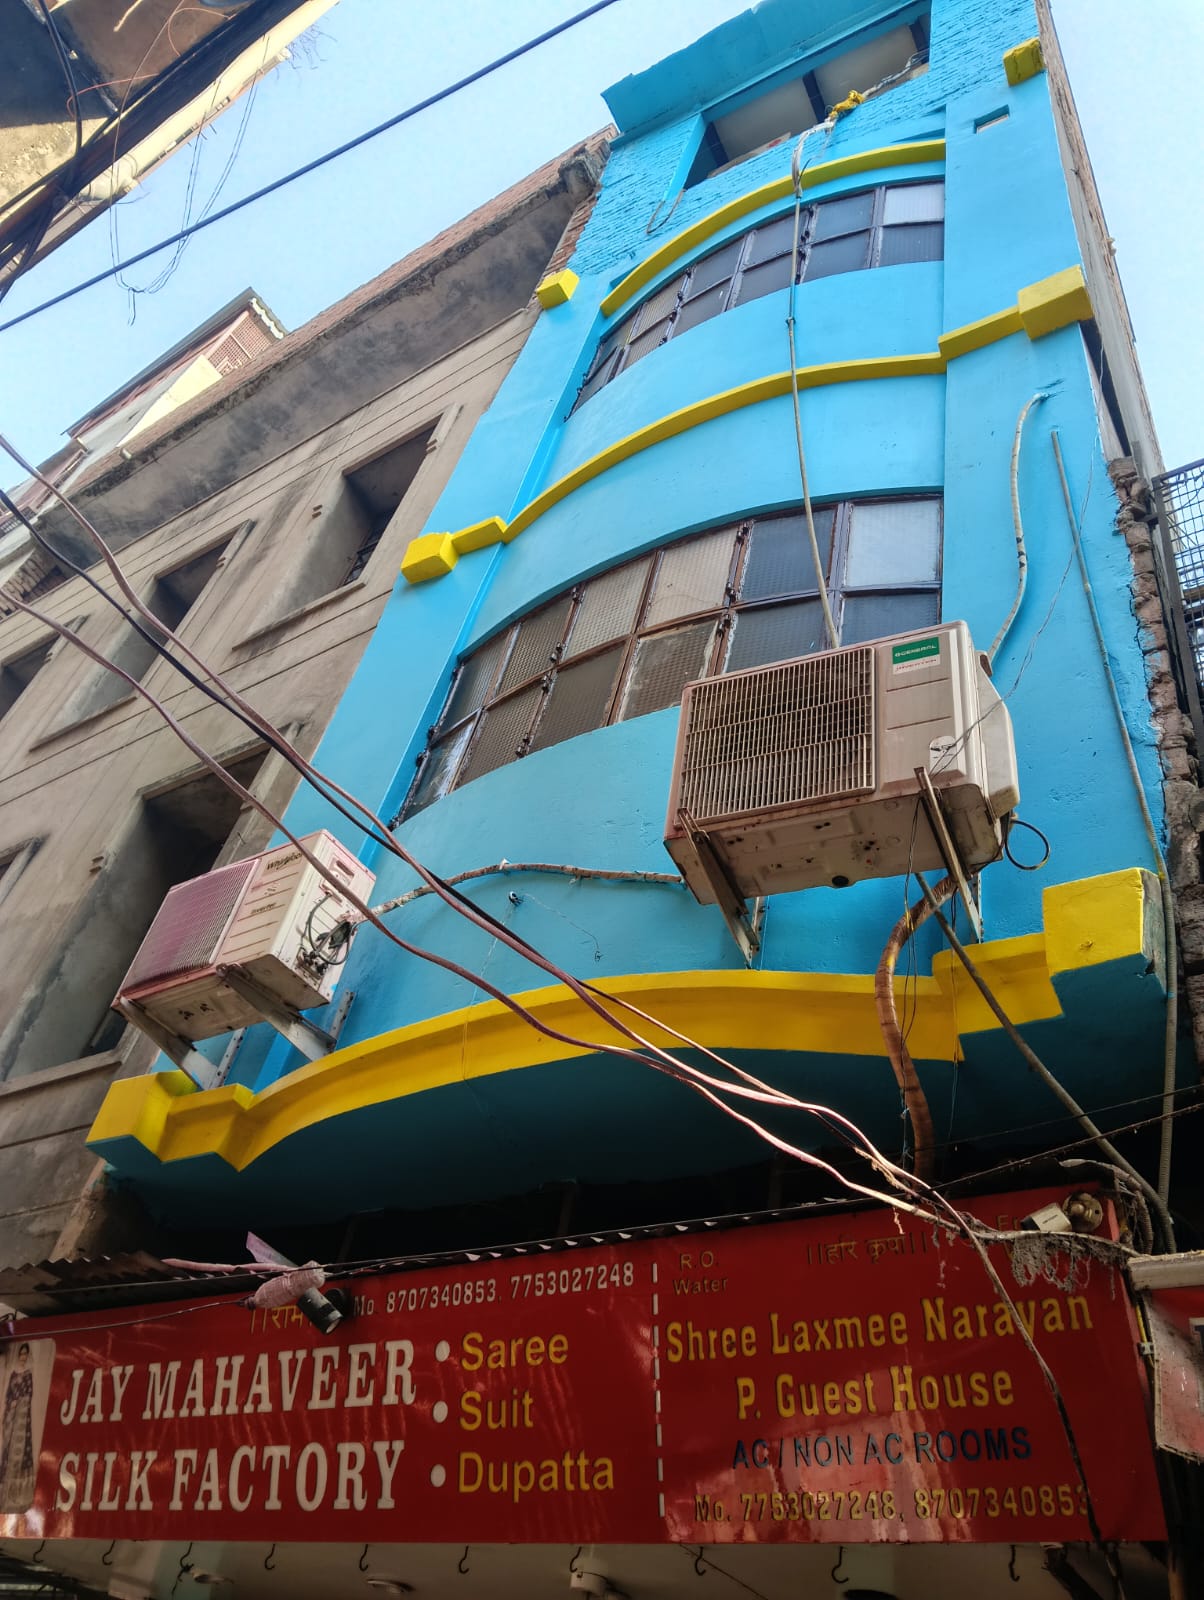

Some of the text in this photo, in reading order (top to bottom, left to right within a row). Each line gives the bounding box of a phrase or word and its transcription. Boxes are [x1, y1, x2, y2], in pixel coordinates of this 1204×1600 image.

[511, 1262, 635, 1299] 7753027248
[672, 1276, 729, 1296] Water
[666, 1294, 1094, 1363] Shree Laxmee Narayan
[461, 1332, 569, 1371] Saree
[60, 1339, 417, 1426] JAY MAHAVEER
[736, 1365, 1015, 1420] P. Guest House
[460, 1389, 534, 1430] Suit
[864, 1433, 904, 1465] AC
[914, 1426, 1033, 1464] ROOMS
[56, 1440, 405, 1512] SILK FACTORY
[459, 1450, 615, 1503] Dupatta
[694, 1492, 731, 1522] Mo.
